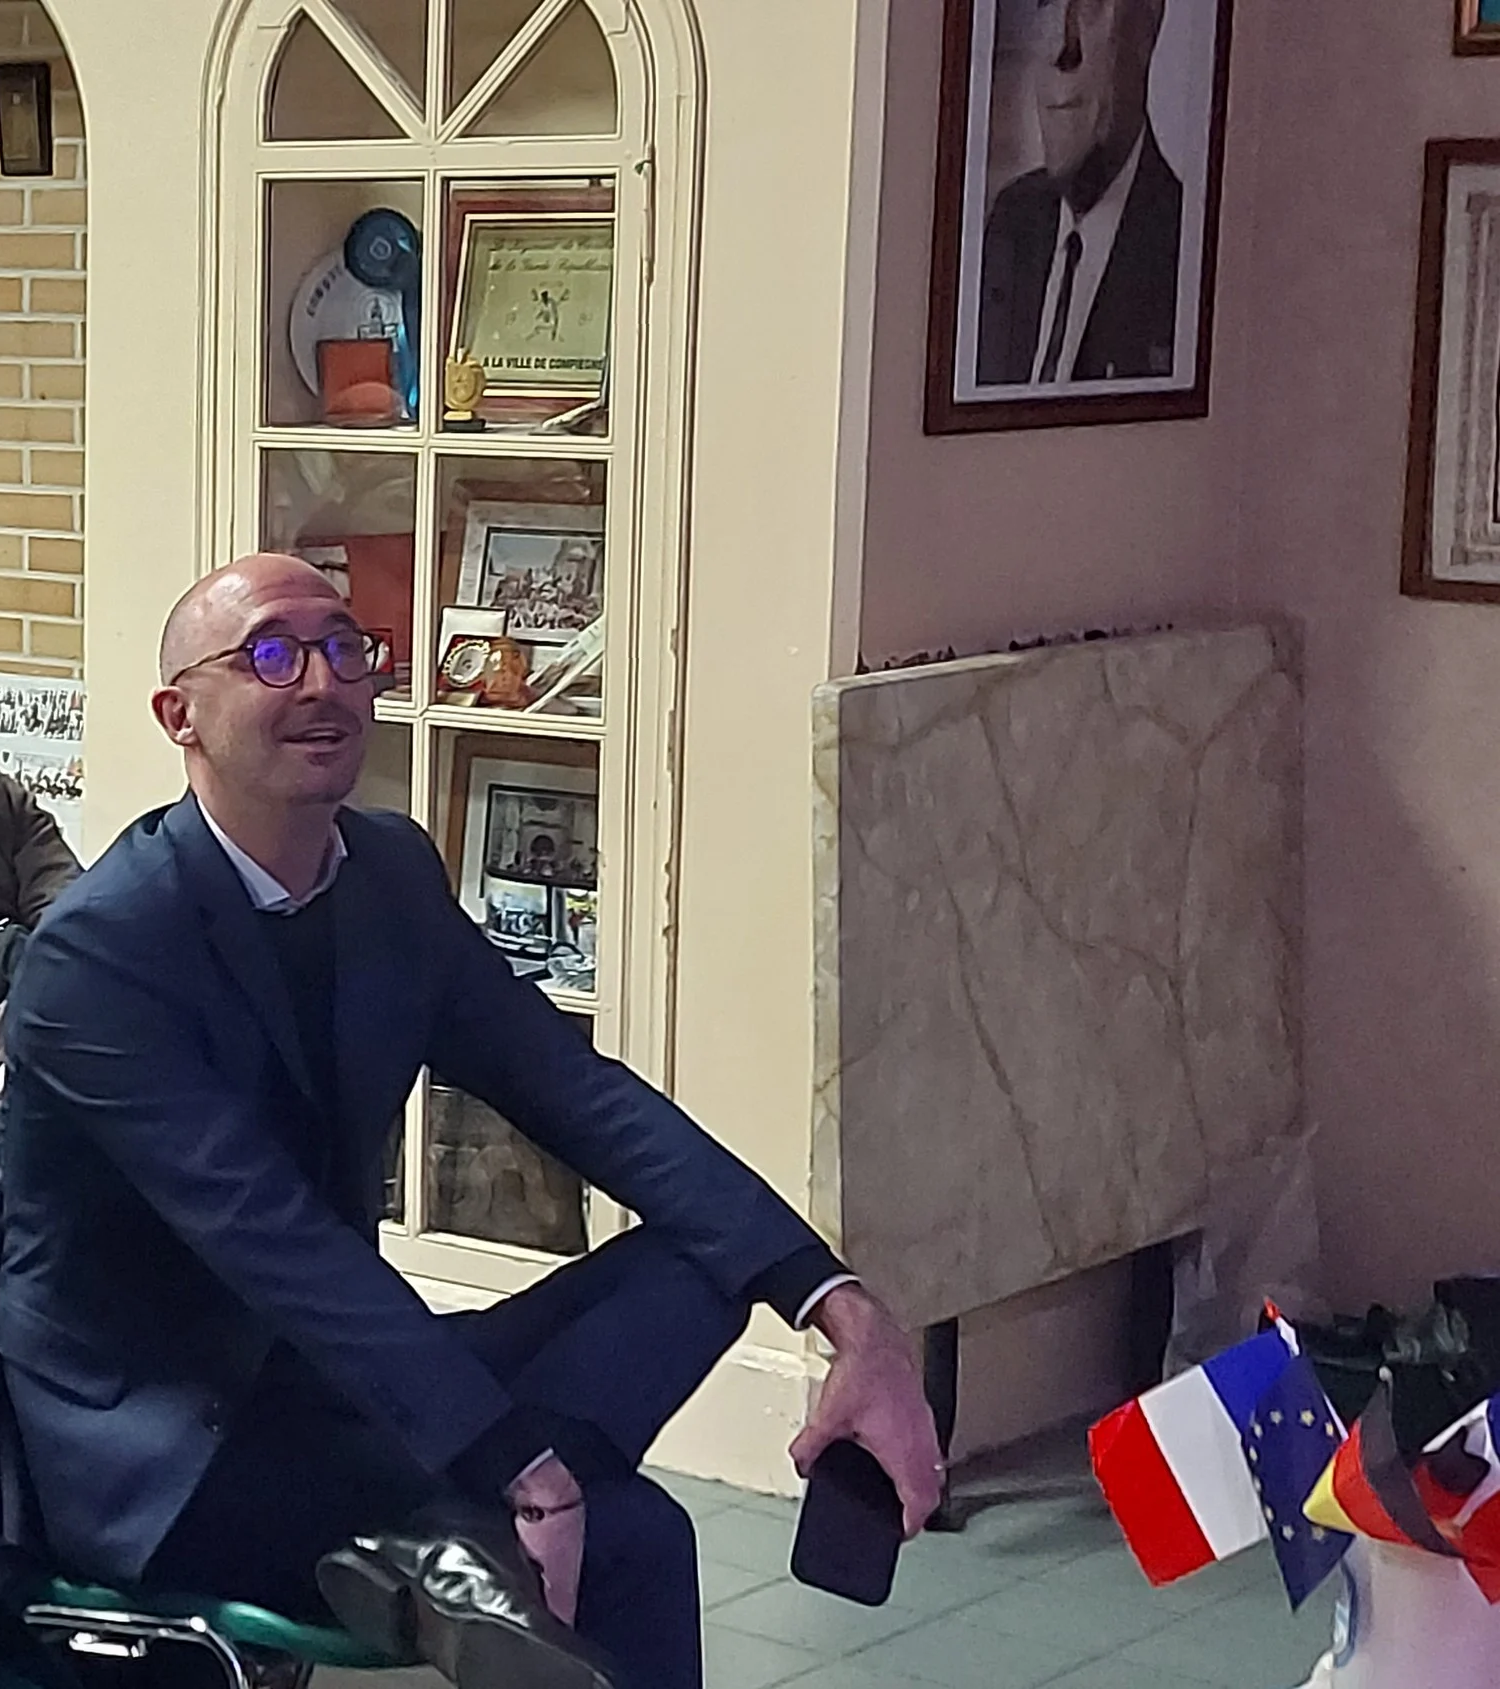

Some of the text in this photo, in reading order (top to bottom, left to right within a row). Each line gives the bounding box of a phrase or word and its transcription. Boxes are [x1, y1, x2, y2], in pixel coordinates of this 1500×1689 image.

[482, 357, 489, 367] A
[491, 357, 503, 368] LA
[506, 357, 531, 369] VILLE
[534, 357, 546, 369] DE
